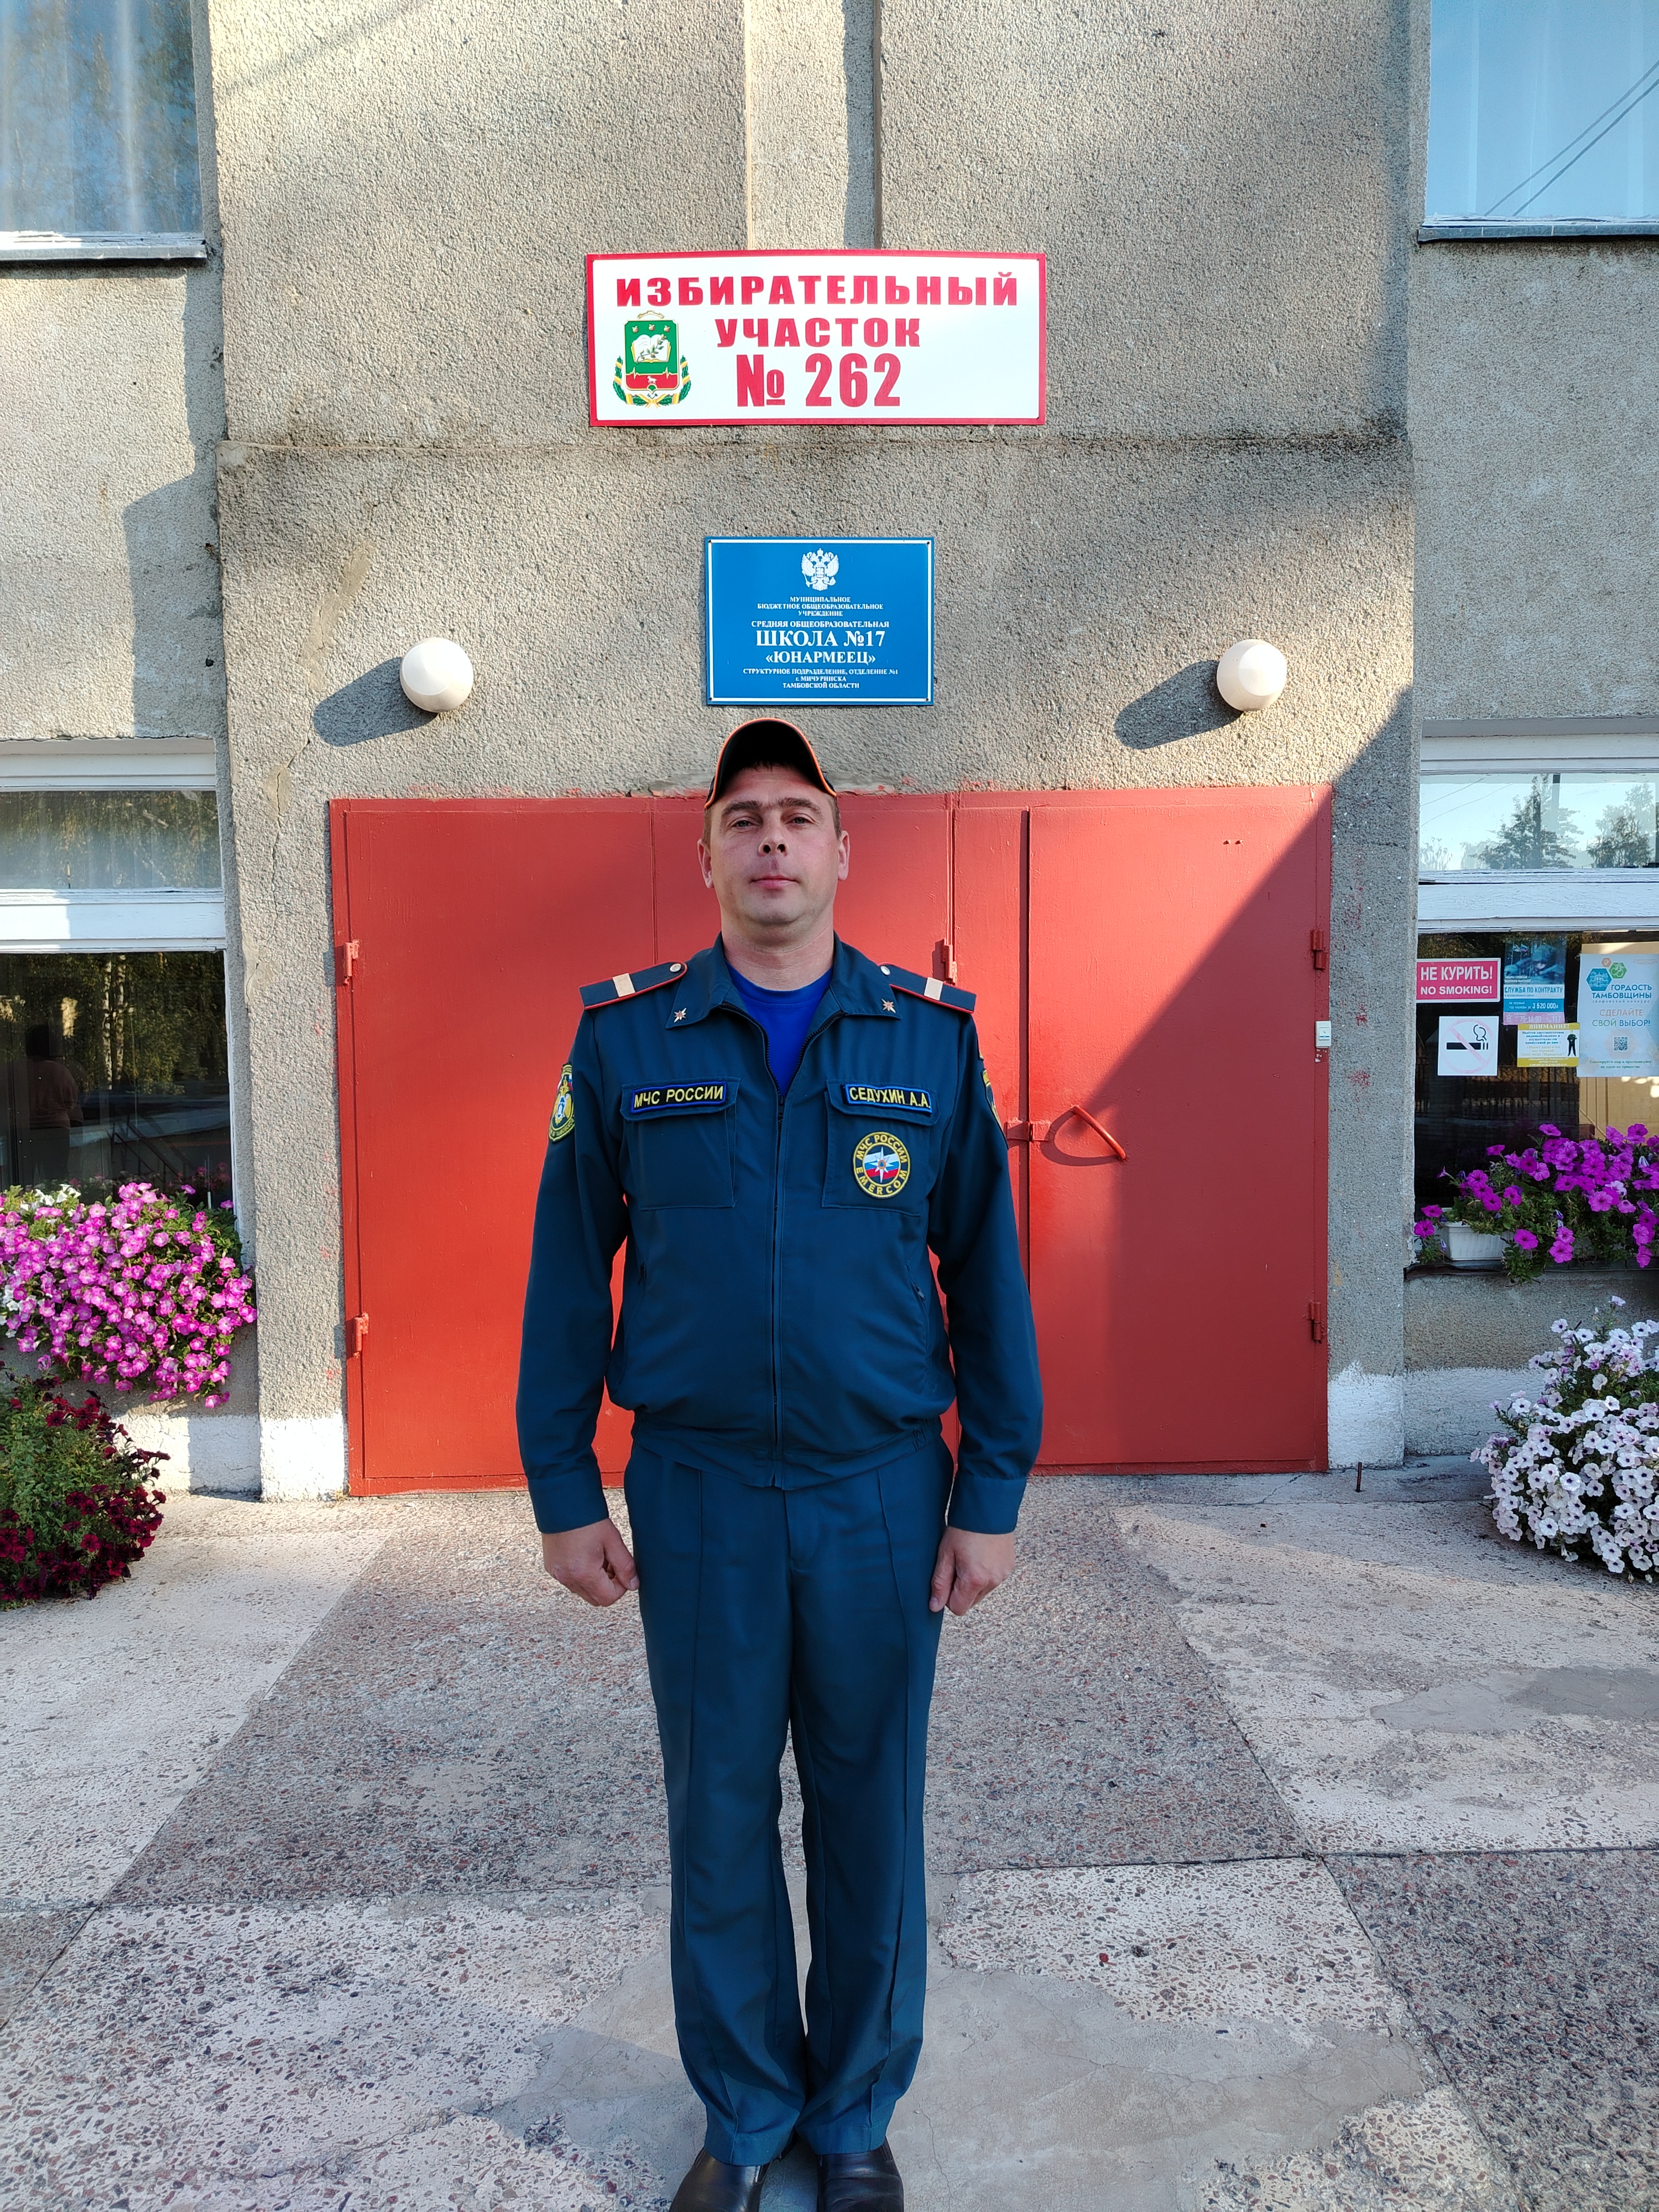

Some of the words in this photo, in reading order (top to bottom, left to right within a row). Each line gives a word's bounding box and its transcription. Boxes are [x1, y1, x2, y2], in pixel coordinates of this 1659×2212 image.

[617, 272, 1017, 307] ИЗБИРАТЕЛЬНЫЙ
[715, 318, 921, 348] УЧАСТОК
[737, 354, 785, 407] №
[805, 353, 901, 407] 262
[756, 630, 838, 646] ШКОЛА
[843, 630, 885, 647] №17
[765, 651, 876, 666] «ЮНАРМЕЕЦ»
[1421, 967, 1438, 980] НЕ
[1441, 966, 1493, 980] КУРИТЬ!
[1421, 986, 1437, 995] NO
[1439, 985, 1492, 995] SMOKING!
[1599, 1008, 1643, 1016] СДЕЛАЙТЕ
[1592, 1018, 1616, 1026] СВОЙ
[634, 1091, 660, 1108] МЧС
[666, 1086, 723, 1102] РОССИИ
[849, 1087, 905, 1104] СЕДУХИН
[856, 1138, 872, 1161] МЧС
[874, 1135, 907, 1163] РОССИИ
[856, 1166, 907, 1194] EMERCOM
